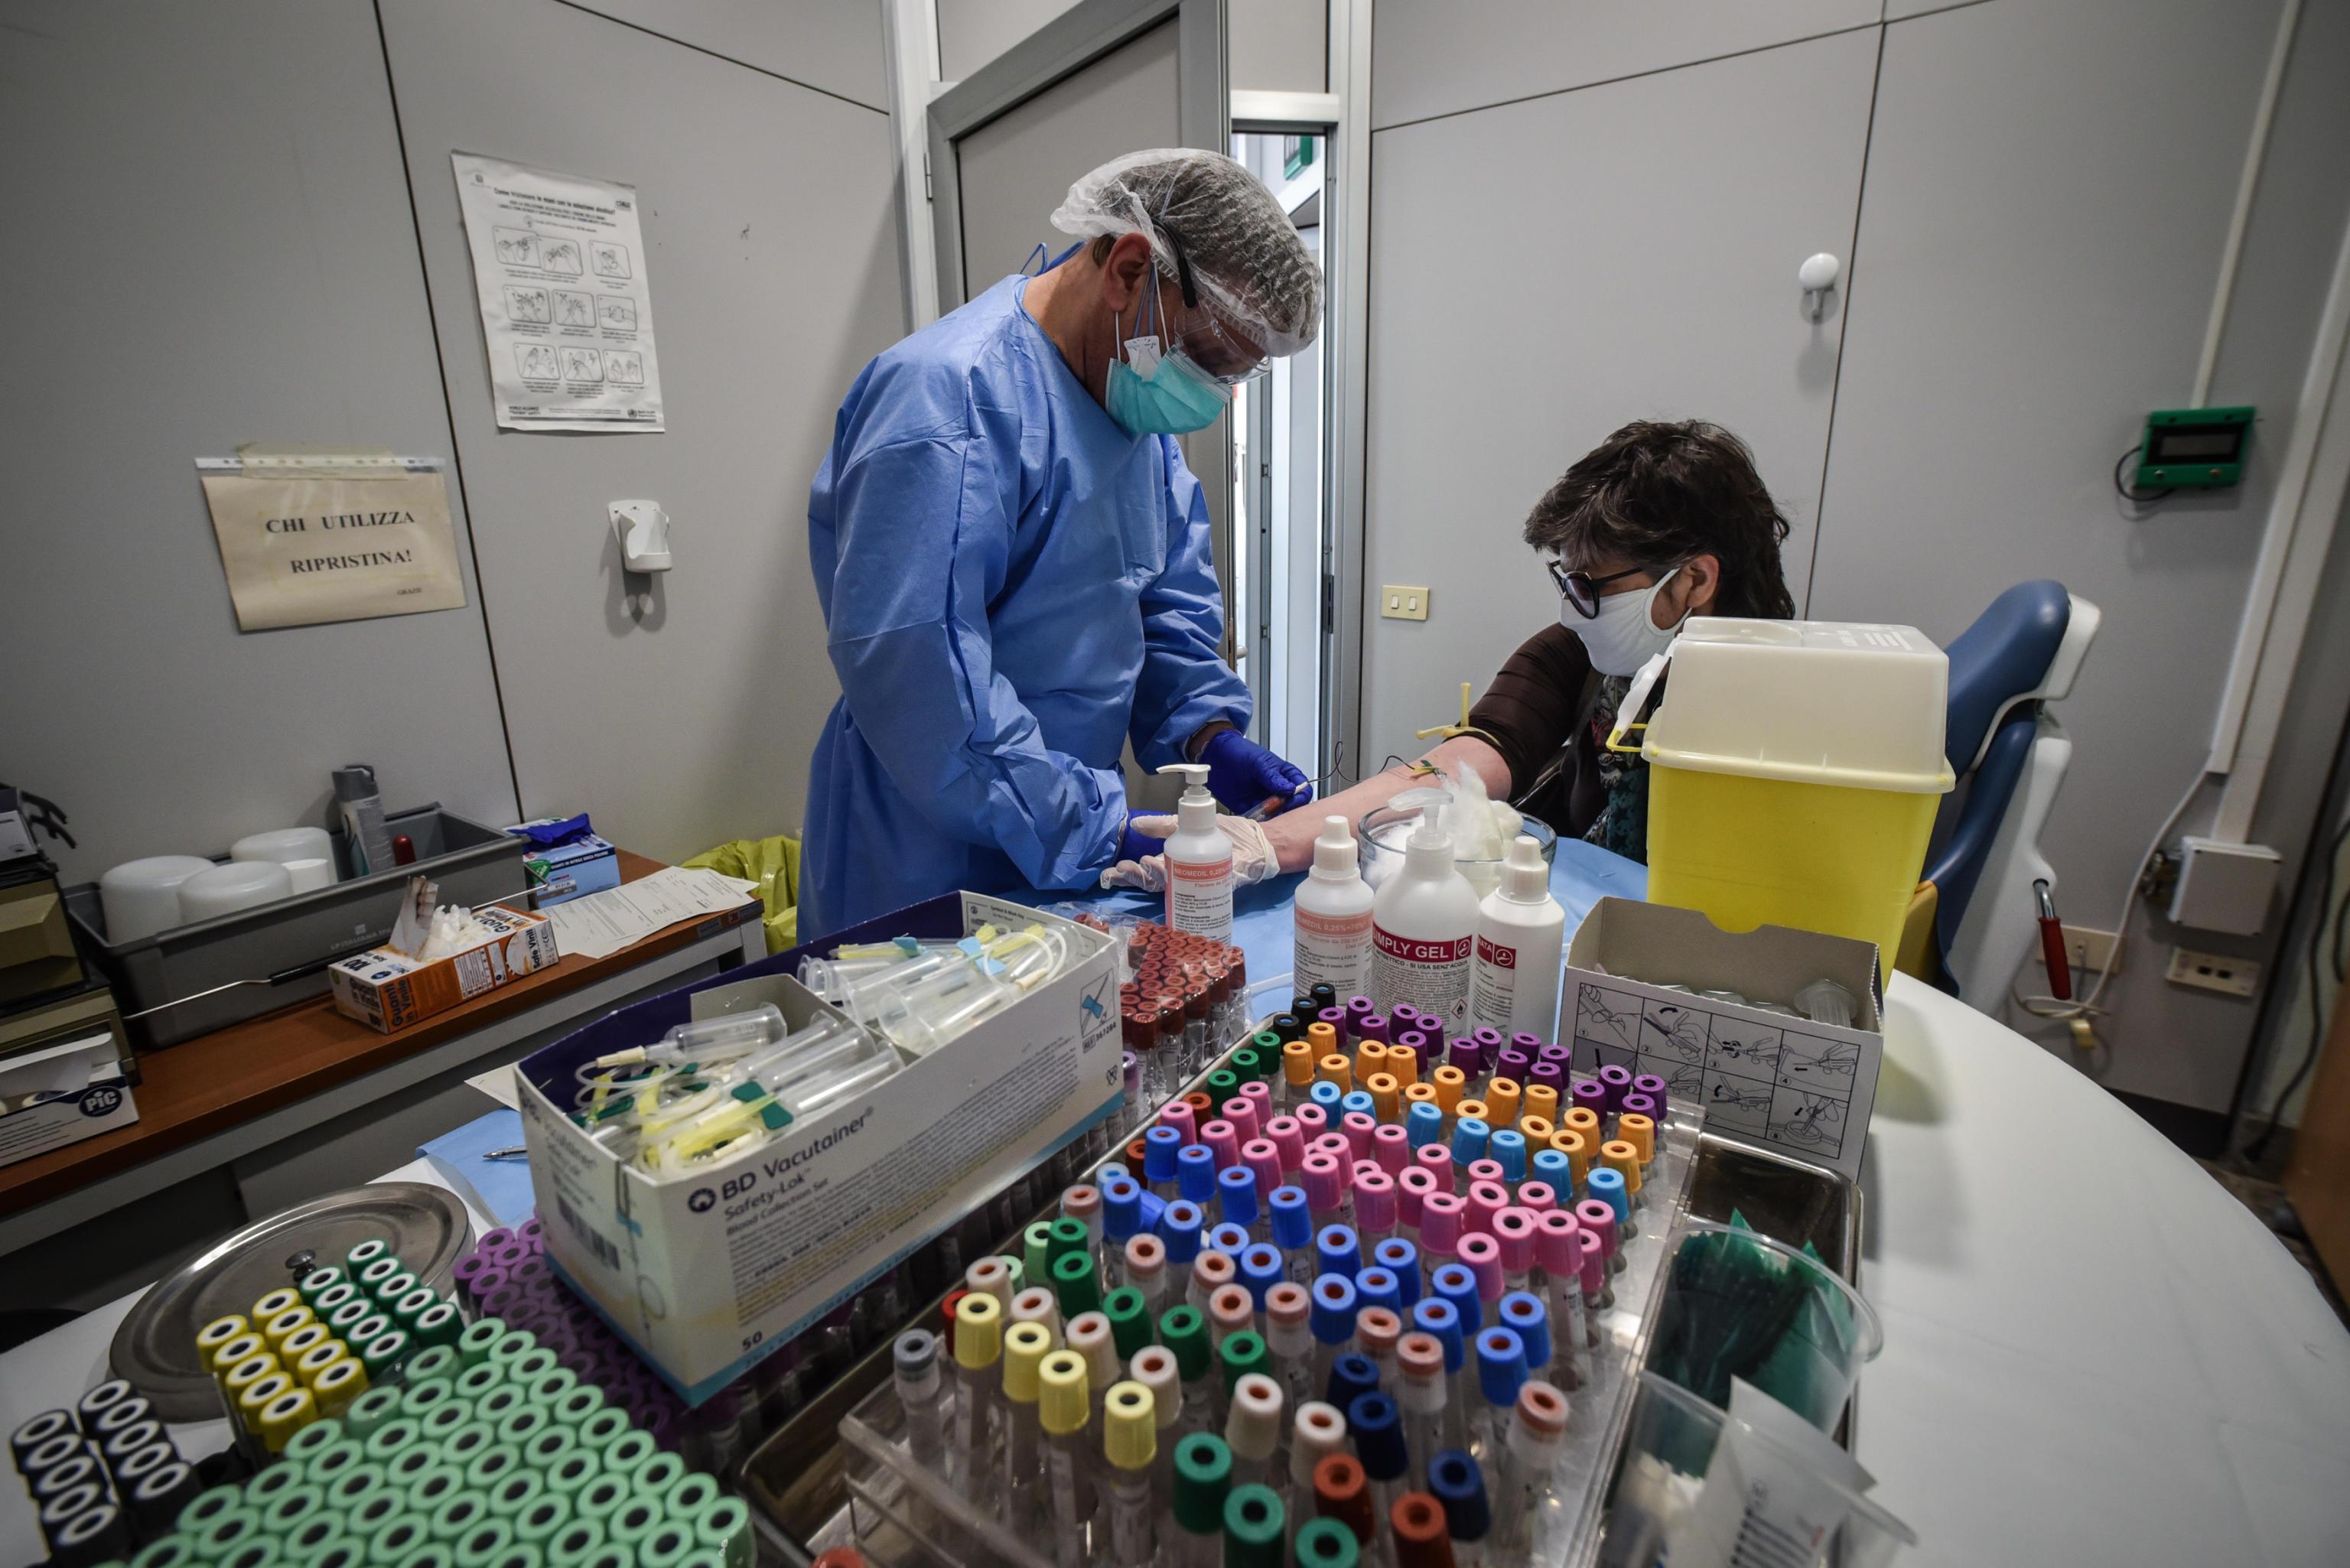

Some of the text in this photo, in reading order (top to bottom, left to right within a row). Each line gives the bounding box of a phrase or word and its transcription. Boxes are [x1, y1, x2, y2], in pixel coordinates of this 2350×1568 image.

[265, 511, 415, 533] CHI UTILIZZA
[291, 549, 412, 574] RIPRISTINA!
[1174, 868, 1209, 877] NEOMEDIL
[532, 949, 541, 969] Safe
[1415, 945, 1449, 958] GEL
[385, 983, 404, 1026] Guanti
[85, 1091, 117, 1111] PiC
[721, 1172, 757, 1202] BD
[742, 1331, 763, 1351] 50
